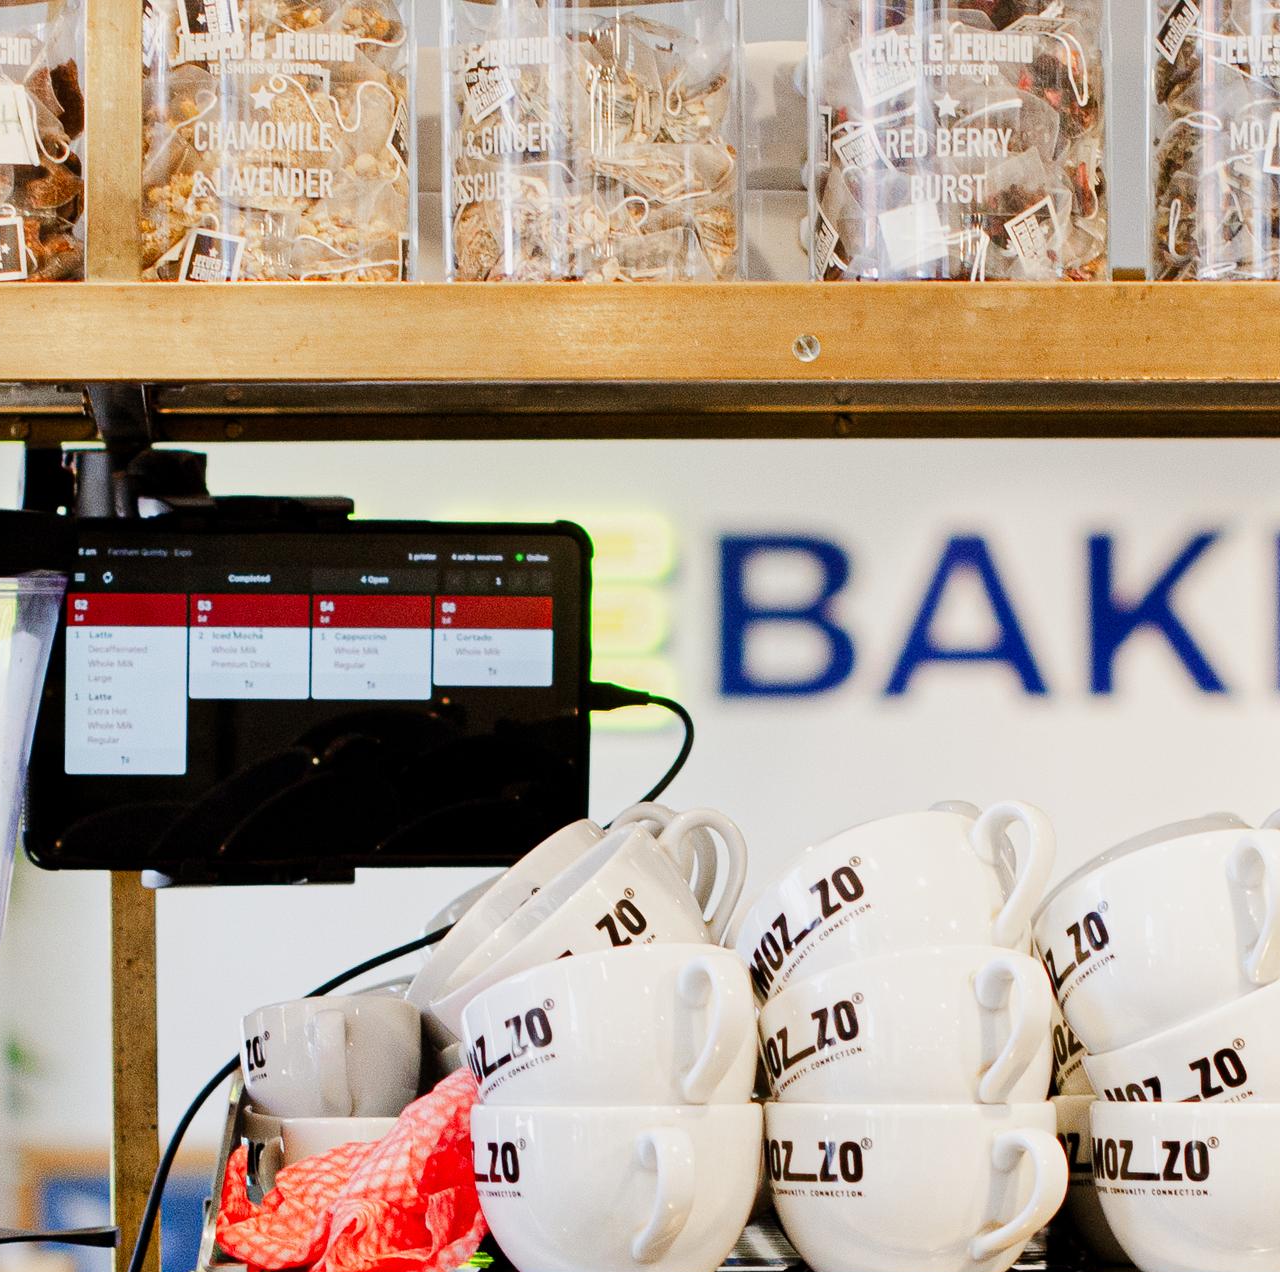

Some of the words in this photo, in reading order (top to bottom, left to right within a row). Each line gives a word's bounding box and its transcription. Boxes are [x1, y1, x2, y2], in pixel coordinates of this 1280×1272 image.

[272, 32, 355, 61] JERICHO
[945, 34, 1026, 63] JERICHO
[960, 63, 999, 76] OXFORD
[193, 121, 333, 152] CHAMOMILE
[481, 122, 556, 154] GINGER
[885, 128, 928, 158] RED
[936, 128, 1012, 158] BERRY
[216, 168, 333, 199] LAVENDER
[911, 174, 987, 204] BURST
[227, 573, 271, 584] Completed
[368, 575, 389, 584] Open
[89, 631, 113, 639] Latte
[212, 631, 232, 640] Iced
[234, 631, 264, 640] Mocha
[334, 632, 387, 641] Cappuccino
[456, 633, 492, 642] Cortado
[88, 646, 148, 654] Decaffeinated
[212, 646, 238, 654] Whole
[240, 646, 257, 654] Milk
[334, 647, 360, 655] Whole
[362, 647, 379, 655] Milk
[456, 648, 482, 656] Whole
[484, 648, 501, 656] Milk
[88, 660, 115, 668] Whole
[117, 660, 134, 668] Milk
[334, 661, 365, 670] Regular
[88, 675, 112, 684] Large
[89, 693, 112, 701] Latte
[88, 707, 110, 715] Extra
[112, 707, 127, 715] Hot
[88, 722, 115, 730] Whole
[116, 722, 133, 730] Milk
[87, 736, 120, 745] Regular
[766, 1000, 859, 1080] OZ_ZO
